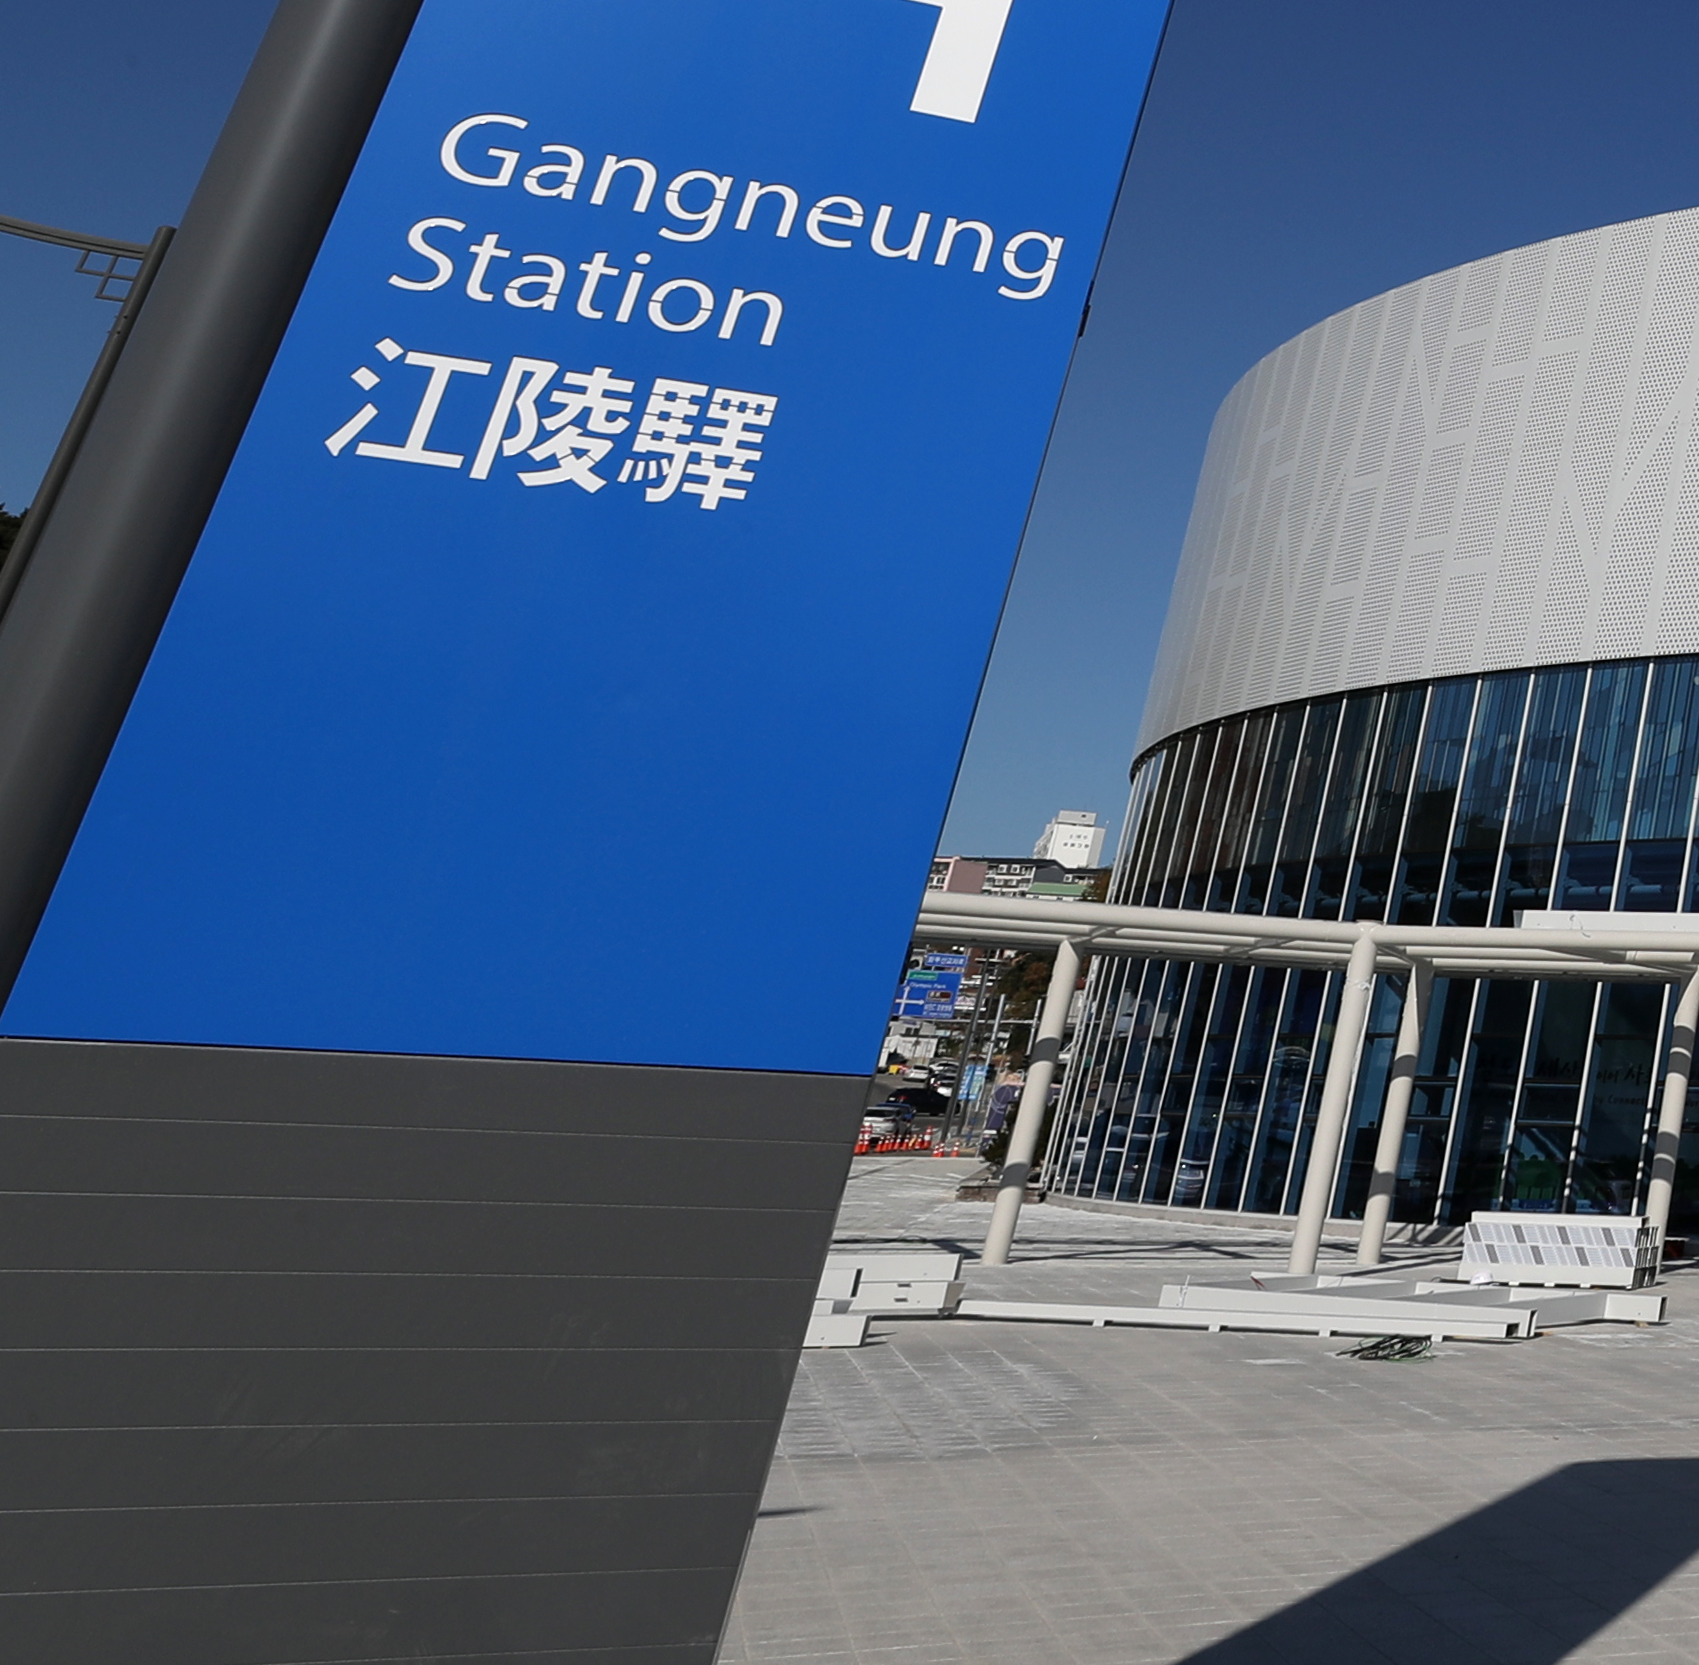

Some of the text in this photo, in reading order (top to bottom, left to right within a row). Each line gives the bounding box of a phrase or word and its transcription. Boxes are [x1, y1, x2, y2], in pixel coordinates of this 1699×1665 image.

[388, 216, 784, 347] Station
[440, 112, 1065, 301] Gangneung
[323, 337, 778, 511] 江陵驛
